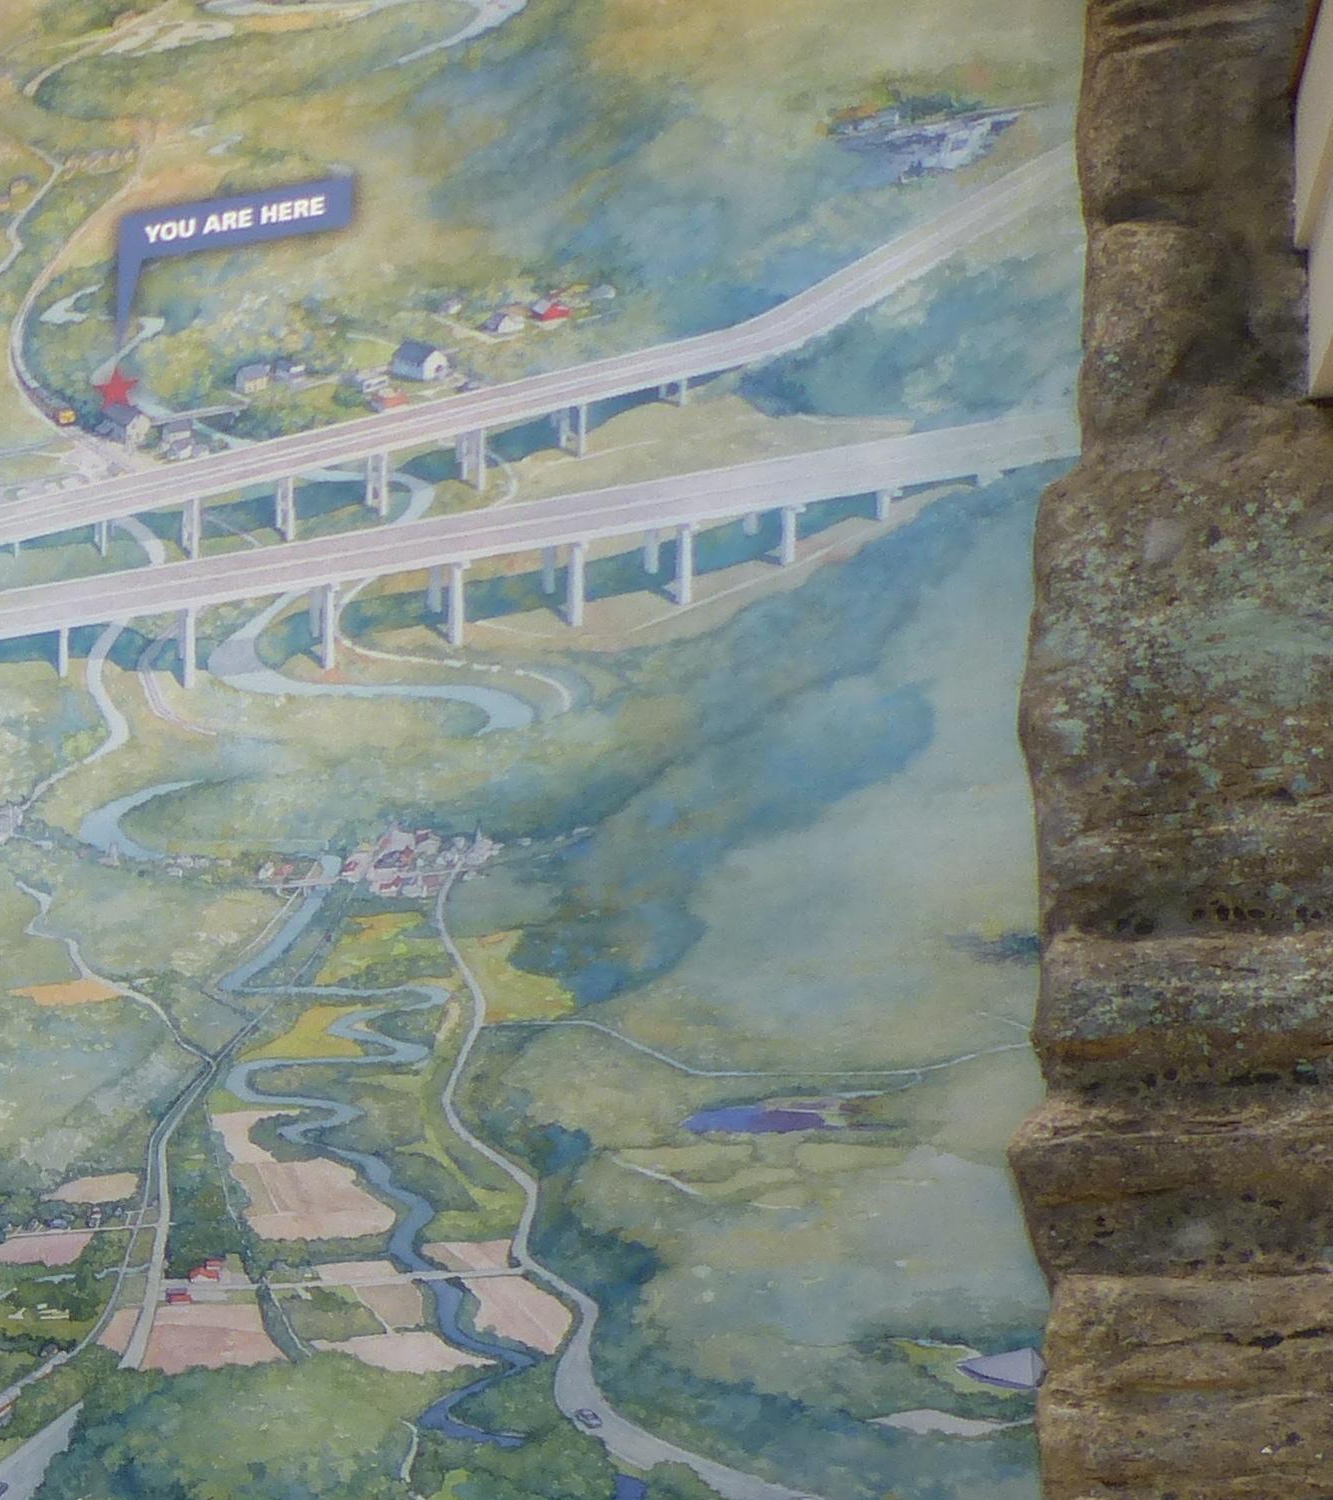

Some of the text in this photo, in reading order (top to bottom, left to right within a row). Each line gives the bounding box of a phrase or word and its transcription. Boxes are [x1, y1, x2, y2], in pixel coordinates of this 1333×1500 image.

[144, 196, 327, 243] YOU ARE HERE
